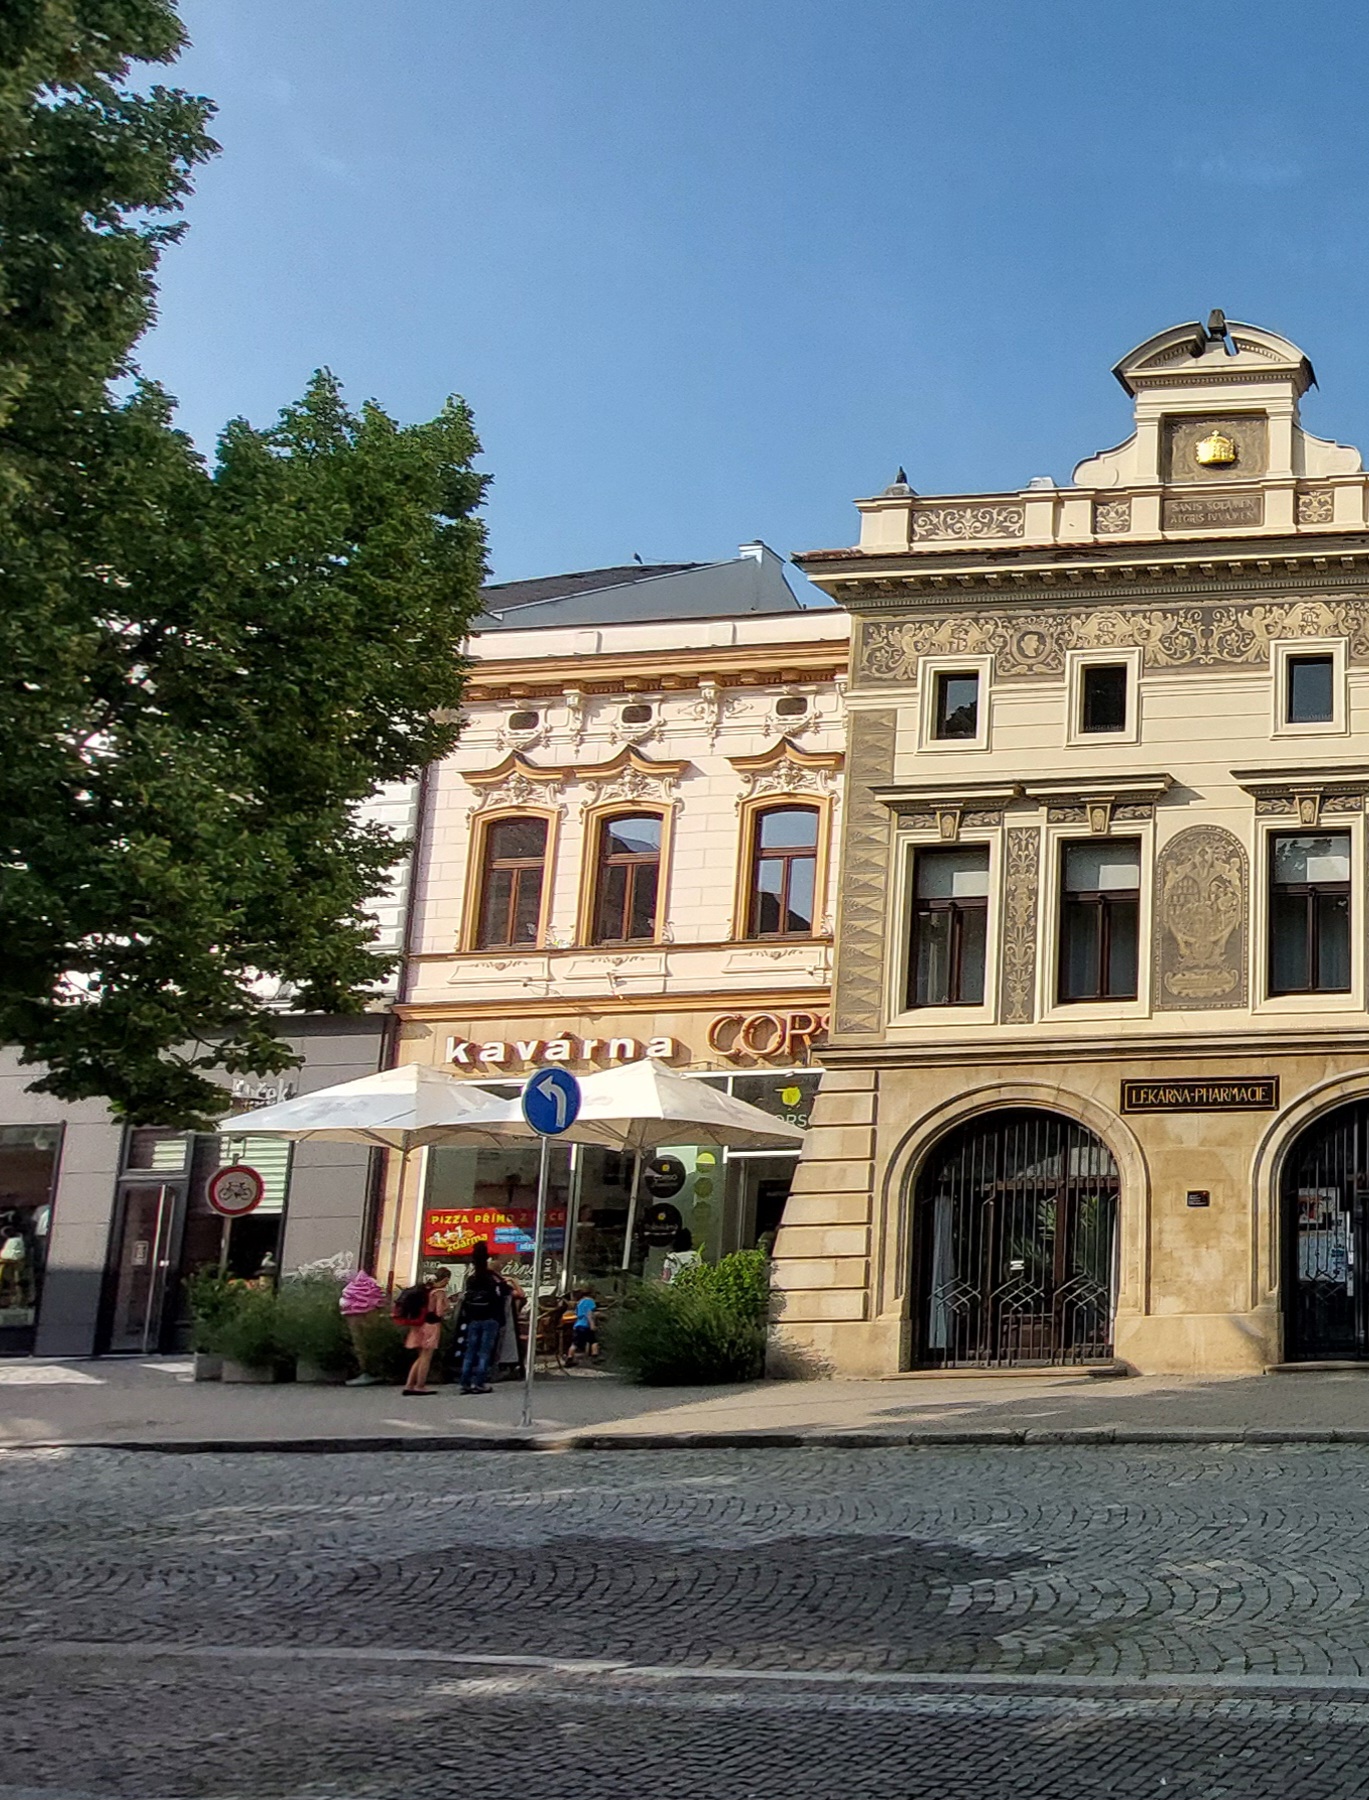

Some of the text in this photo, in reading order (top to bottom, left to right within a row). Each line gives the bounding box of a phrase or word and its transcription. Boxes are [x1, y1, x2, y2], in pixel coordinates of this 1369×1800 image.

[445, 1031, 672, 1064] kavárna
[431, 1214, 469, 1225] PIZZA
[446, 1233, 488, 1253] zdarma
